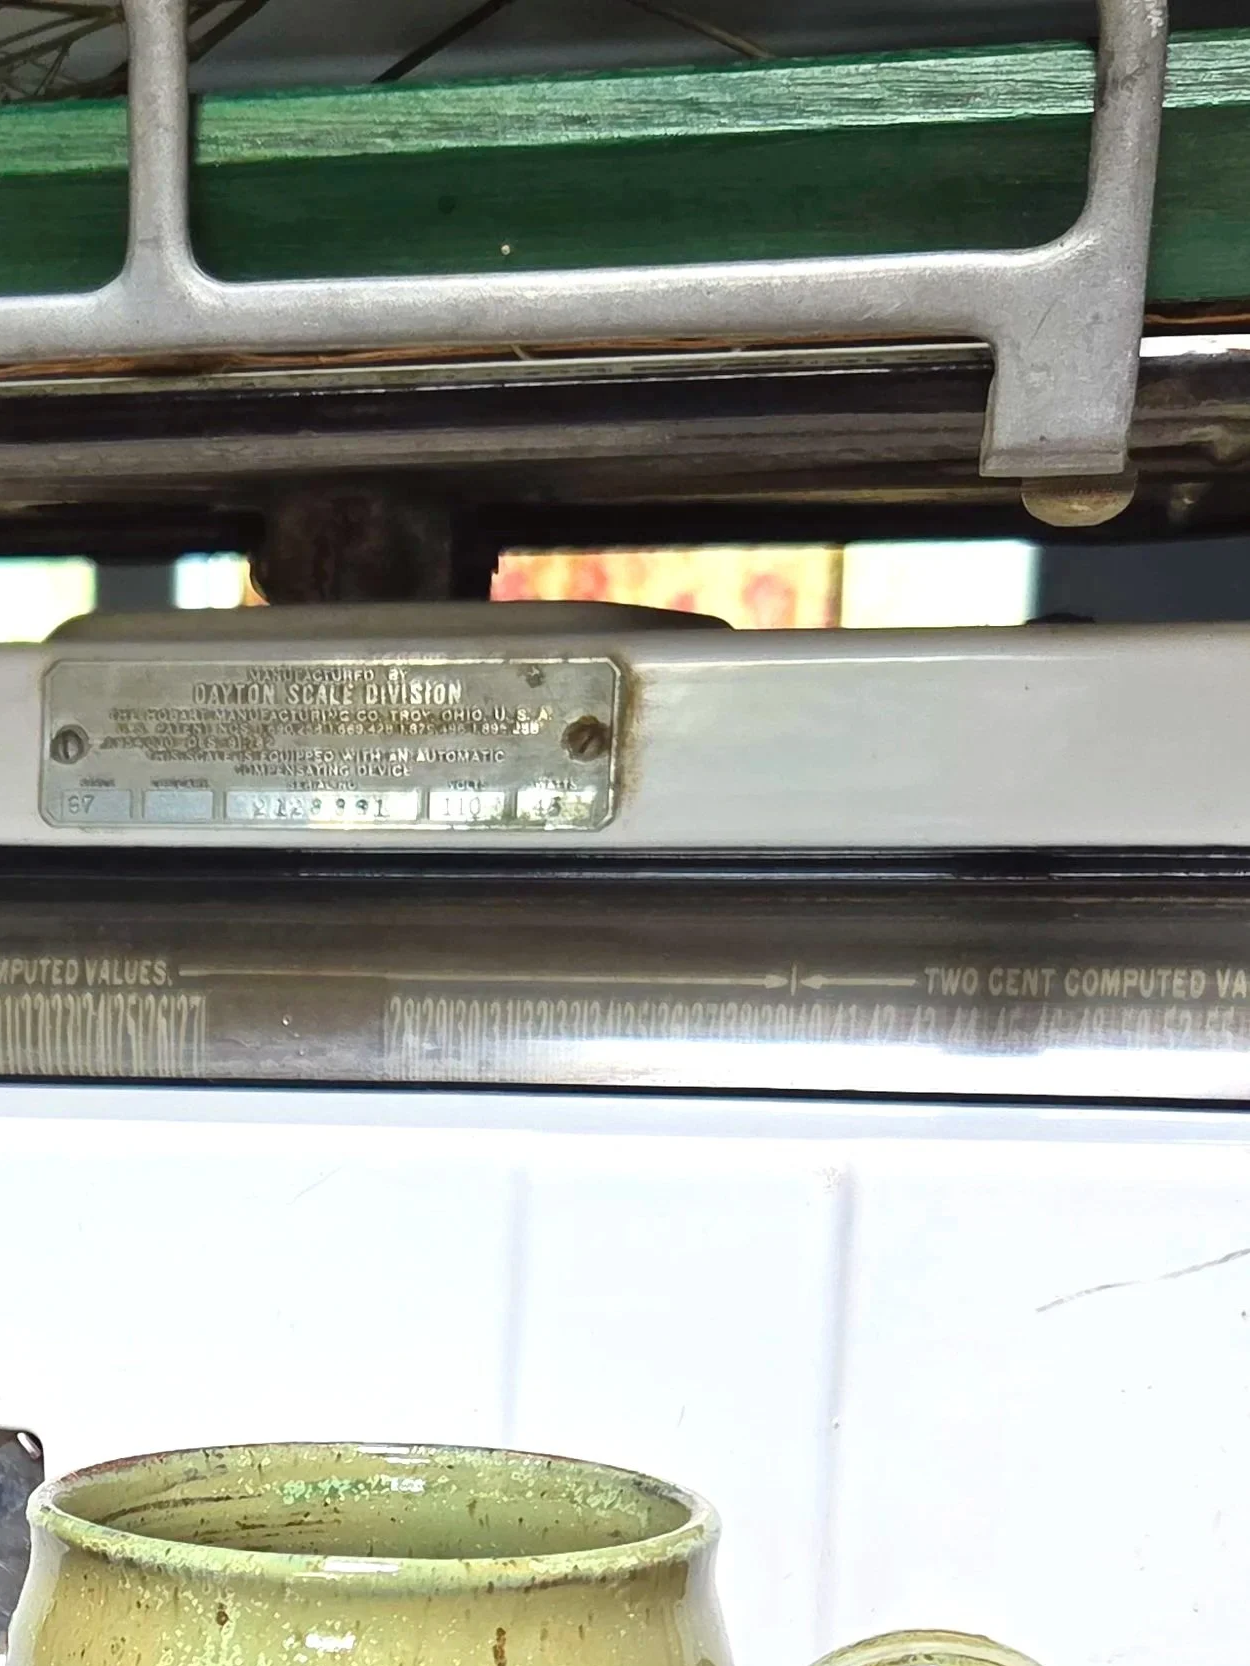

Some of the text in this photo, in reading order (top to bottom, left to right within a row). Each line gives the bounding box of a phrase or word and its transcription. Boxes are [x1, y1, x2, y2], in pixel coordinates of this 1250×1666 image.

[247, 667, 408, 682] MANUFACTURED BY
[193, 680, 462, 705] DAYTON SCALE DIVISION
[216, 708, 350, 722] MANUFACTURING
[260, 749, 335, 762] EQUIPPED
[343, 747, 381, 762] WITH
[389, 747, 408, 762] AN
[416, 748, 506, 763] AUTOMATIC
[357, 764, 412, 777] DEVICE
[84, 957, 173, 988] VALUES.
[924, 966, 979, 997] TWO
[988, 967, 1056, 997] CENT
[1064, 967, 1206, 999] COMPUTED
